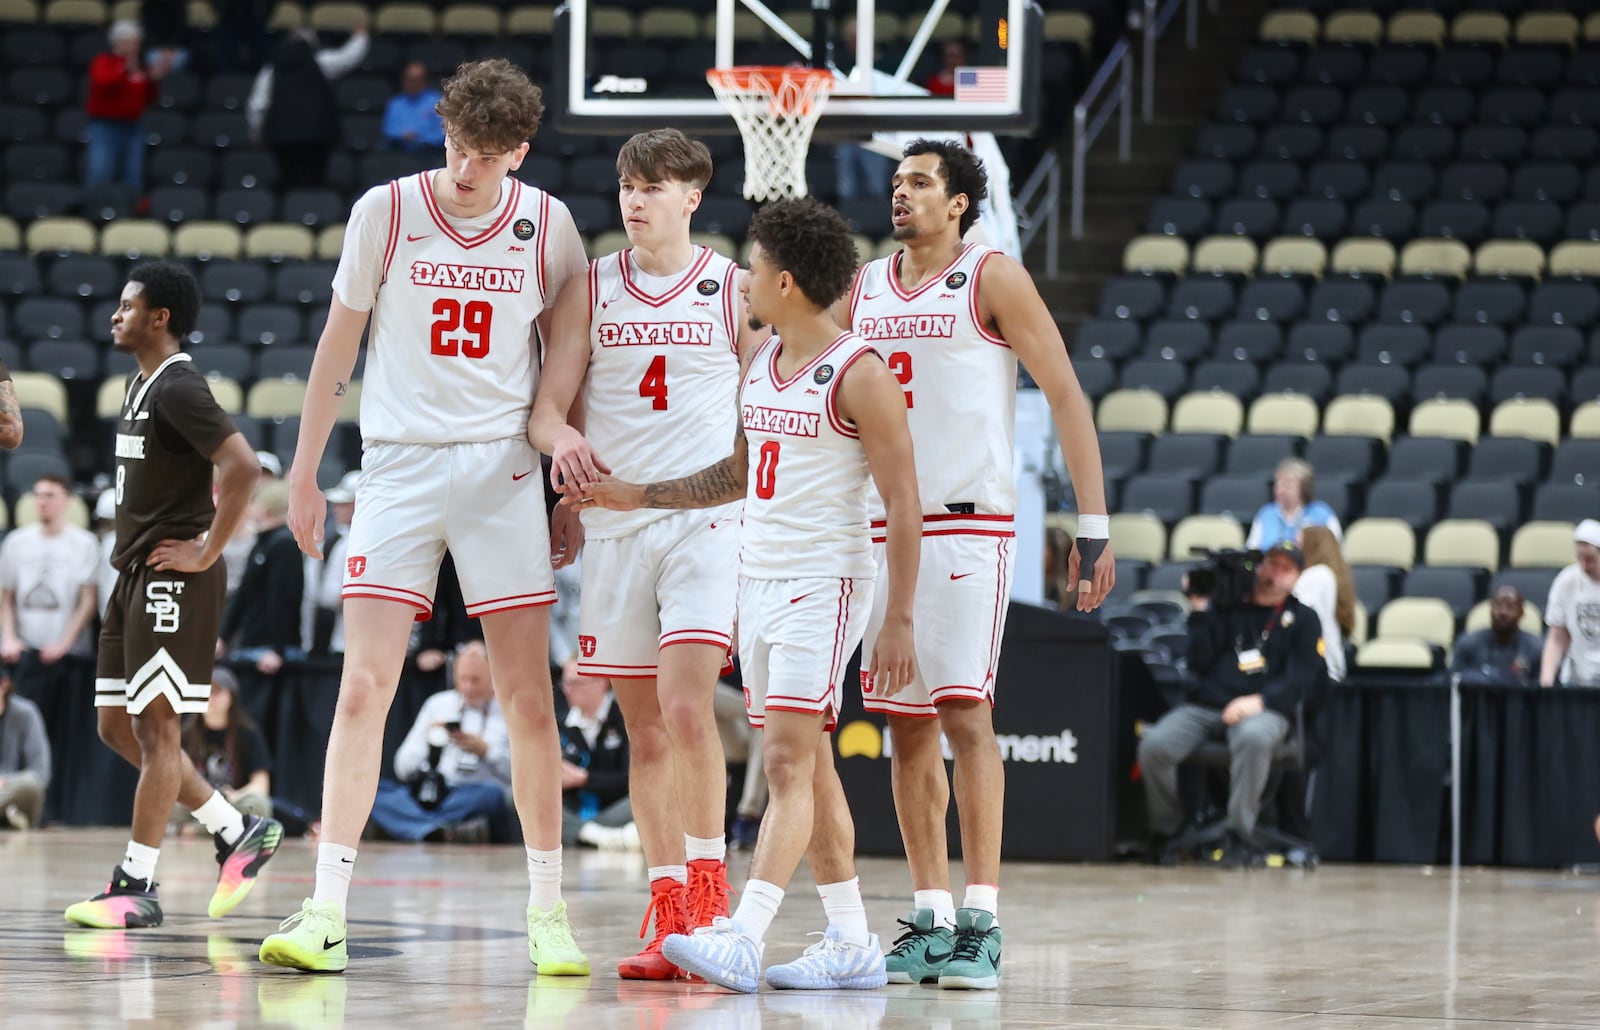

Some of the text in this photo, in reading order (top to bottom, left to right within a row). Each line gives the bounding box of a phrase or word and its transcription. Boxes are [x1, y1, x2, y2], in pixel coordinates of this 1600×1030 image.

[410, 261, 524, 293] DAYTON
[431, 298, 493, 359] 29
[598, 322, 712, 347] DAYTON
[858, 315, 955, 341] DAYTON
[639, 355, 668, 411] 4
[743, 405, 820, 438] DAYTON
[115, 465, 126, 506] 8
[756, 441, 781, 500] 0
[348, 556, 366, 578] D
[578, 635, 597, 657] D
